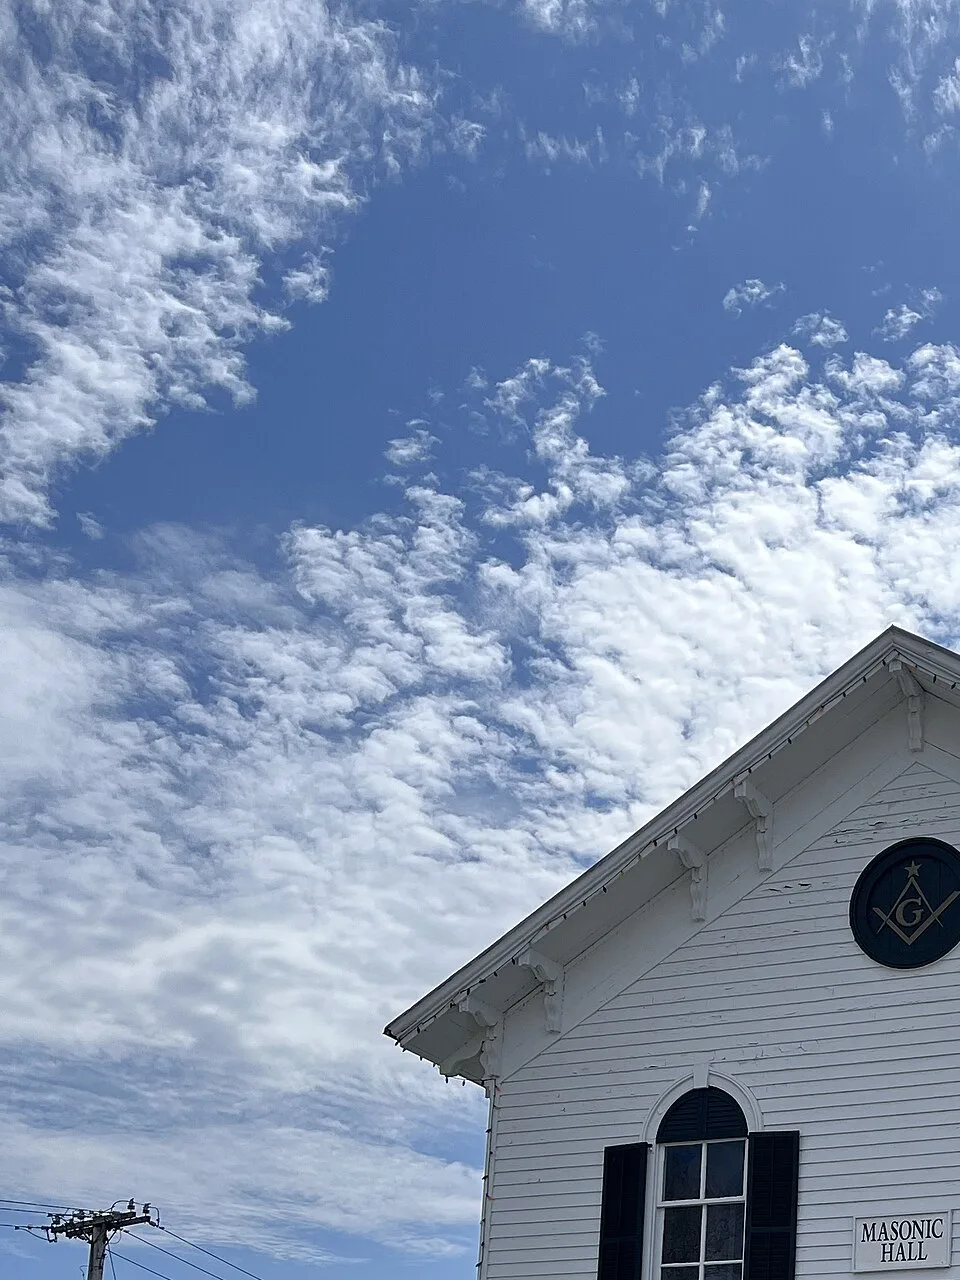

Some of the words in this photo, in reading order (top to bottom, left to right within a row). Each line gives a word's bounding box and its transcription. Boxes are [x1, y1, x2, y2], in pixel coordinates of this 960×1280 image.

[895, 898, 924, 927] G
[861, 1218, 944, 1242] MASONIC
[881, 1241, 928, 1262] HALL
